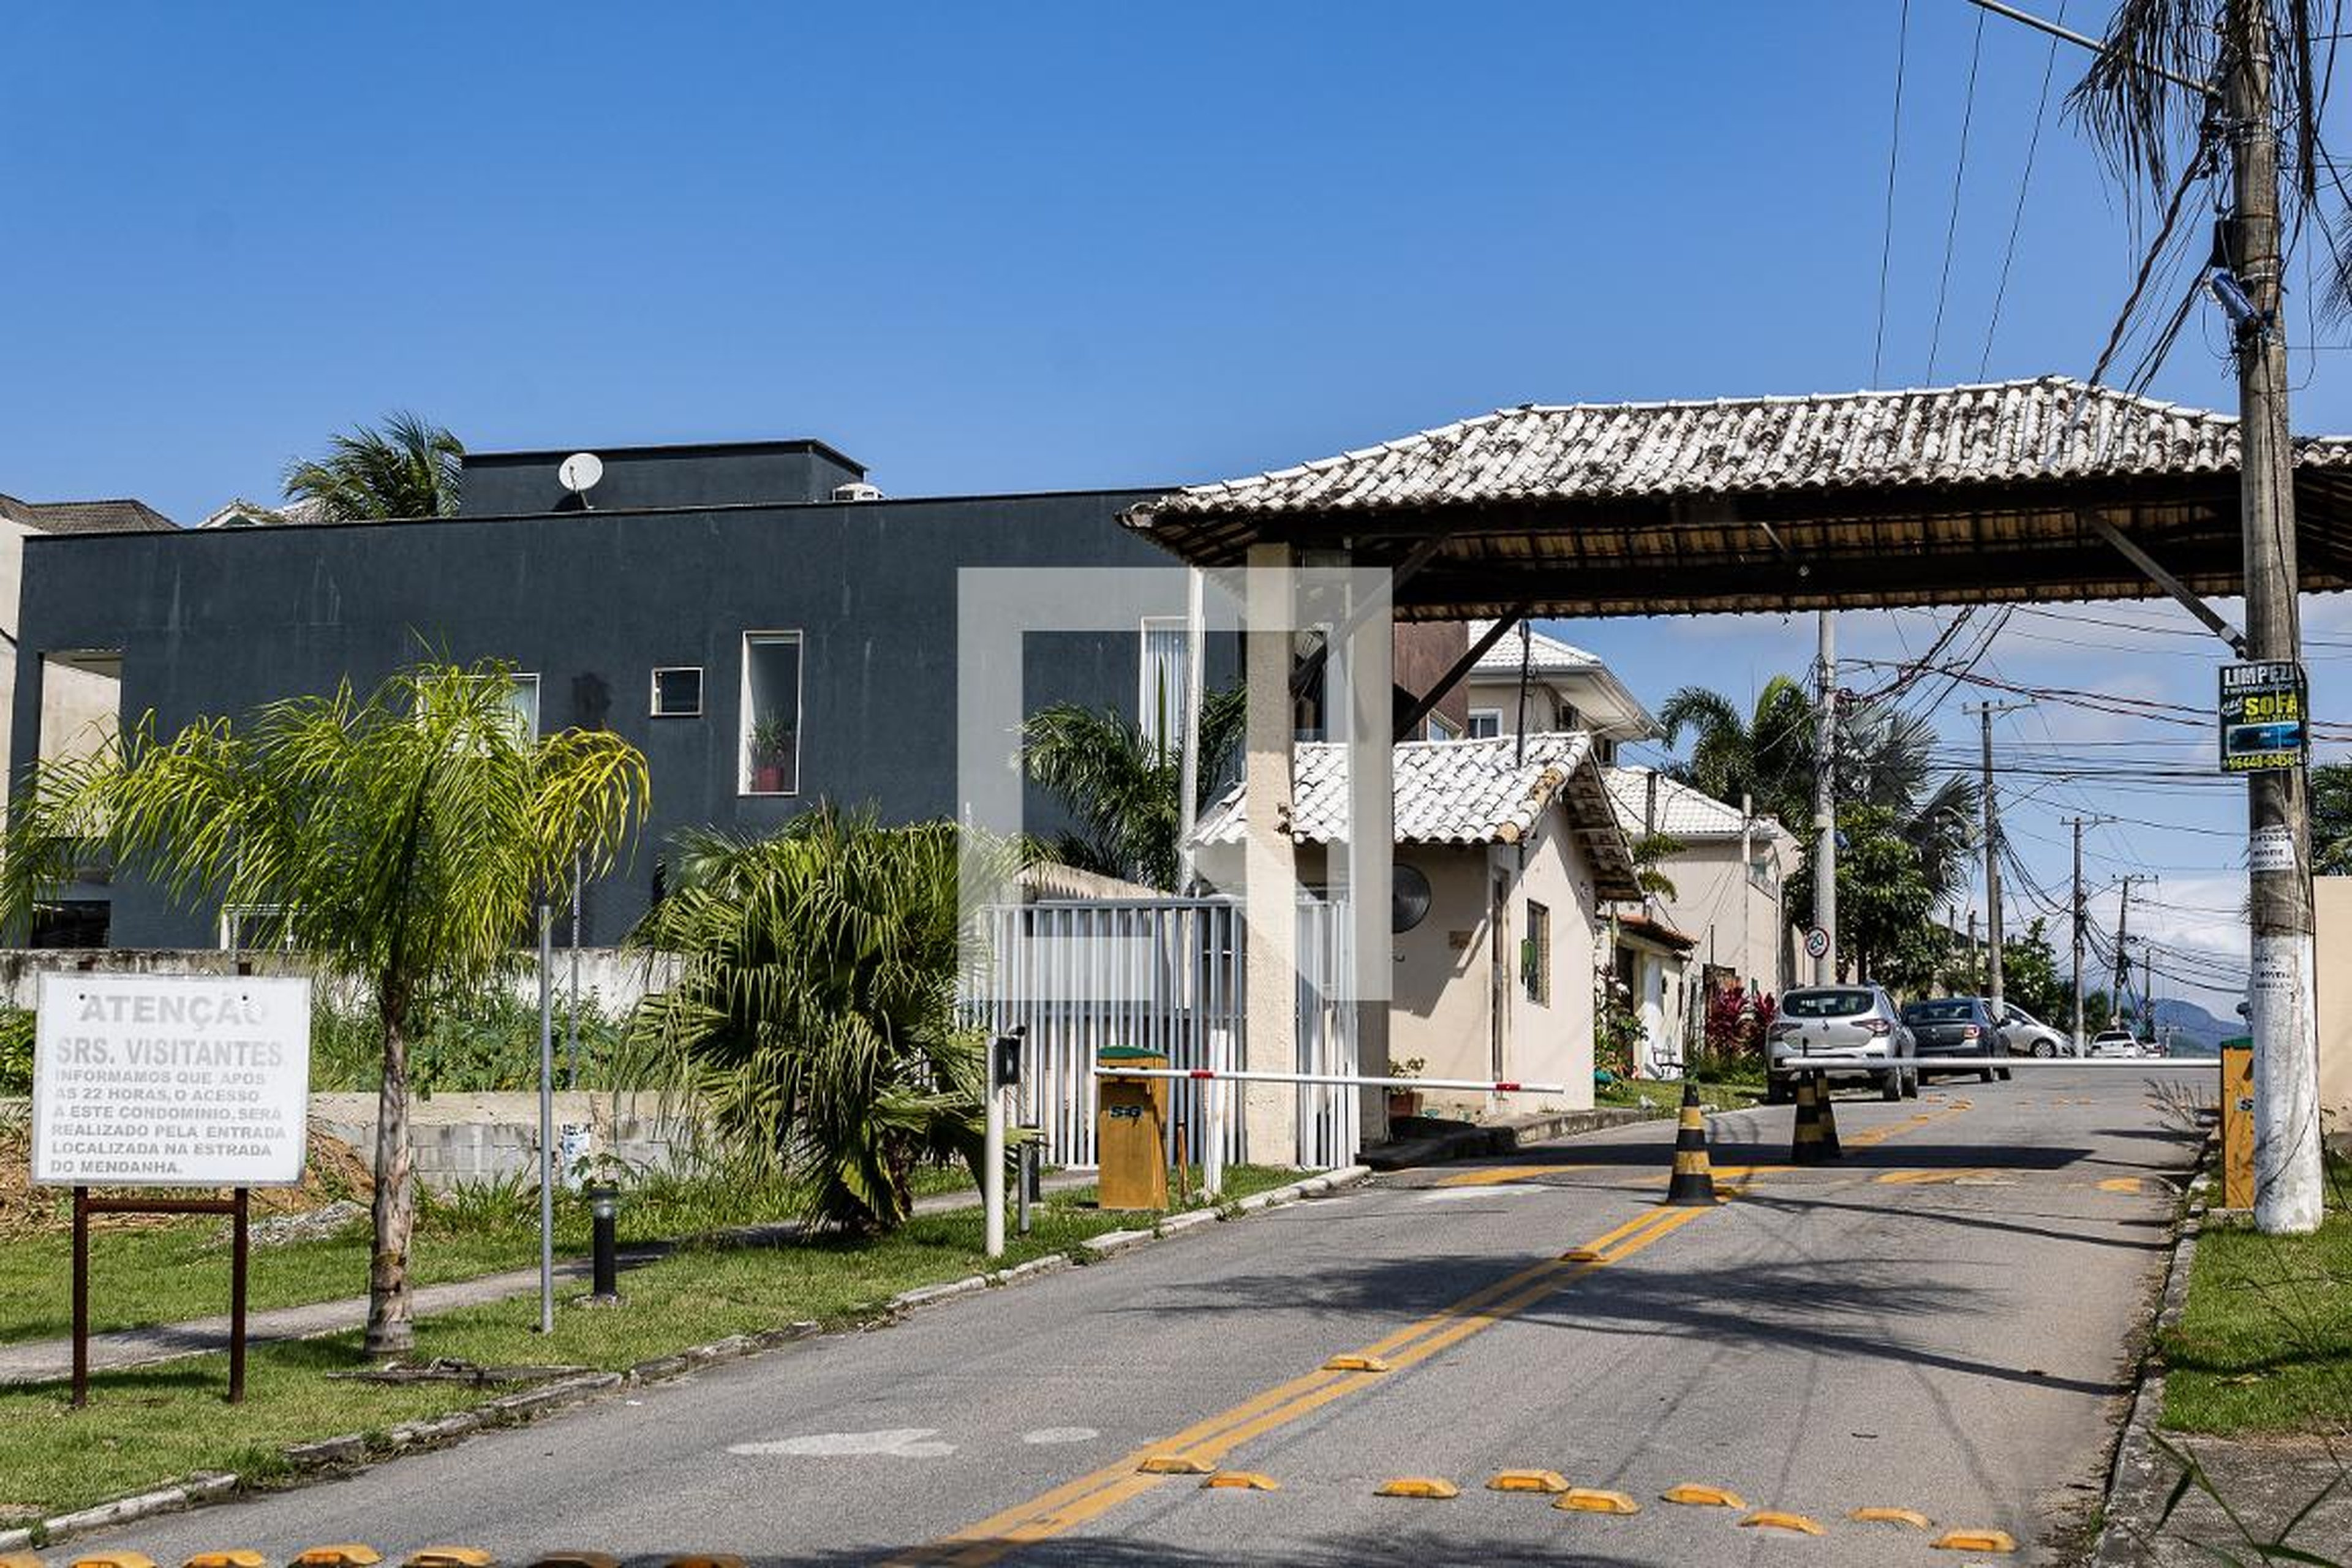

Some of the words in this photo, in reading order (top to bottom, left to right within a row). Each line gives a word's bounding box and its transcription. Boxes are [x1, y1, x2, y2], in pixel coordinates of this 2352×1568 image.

[1809, 933, 1824, 950] 20
[56, 1038, 115, 1065] SRS.
[127, 1038, 282, 1066] VISITANTES
[56, 1069, 171, 1083] INFORMAMOS
[176, 1071, 212, 1085] QUE
[83, 1087, 102, 1099] 22
[175, 1090, 186, 1101] O
[192, 1090, 259, 1102] ACESSO
[70, 1106, 113, 1118] ESTE
[51, 1124, 148, 1137] REALIZADO
[155, 1125, 198, 1138] PELA
[206, 1126, 287, 1139] ENTRADA
[52, 1142, 159, 1155] LOCALIZADA
[164, 1143, 188, 1155] NA
[194, 1143, 272, 1156] ESTRADA
[51, 1159, 74, 1173] DO
